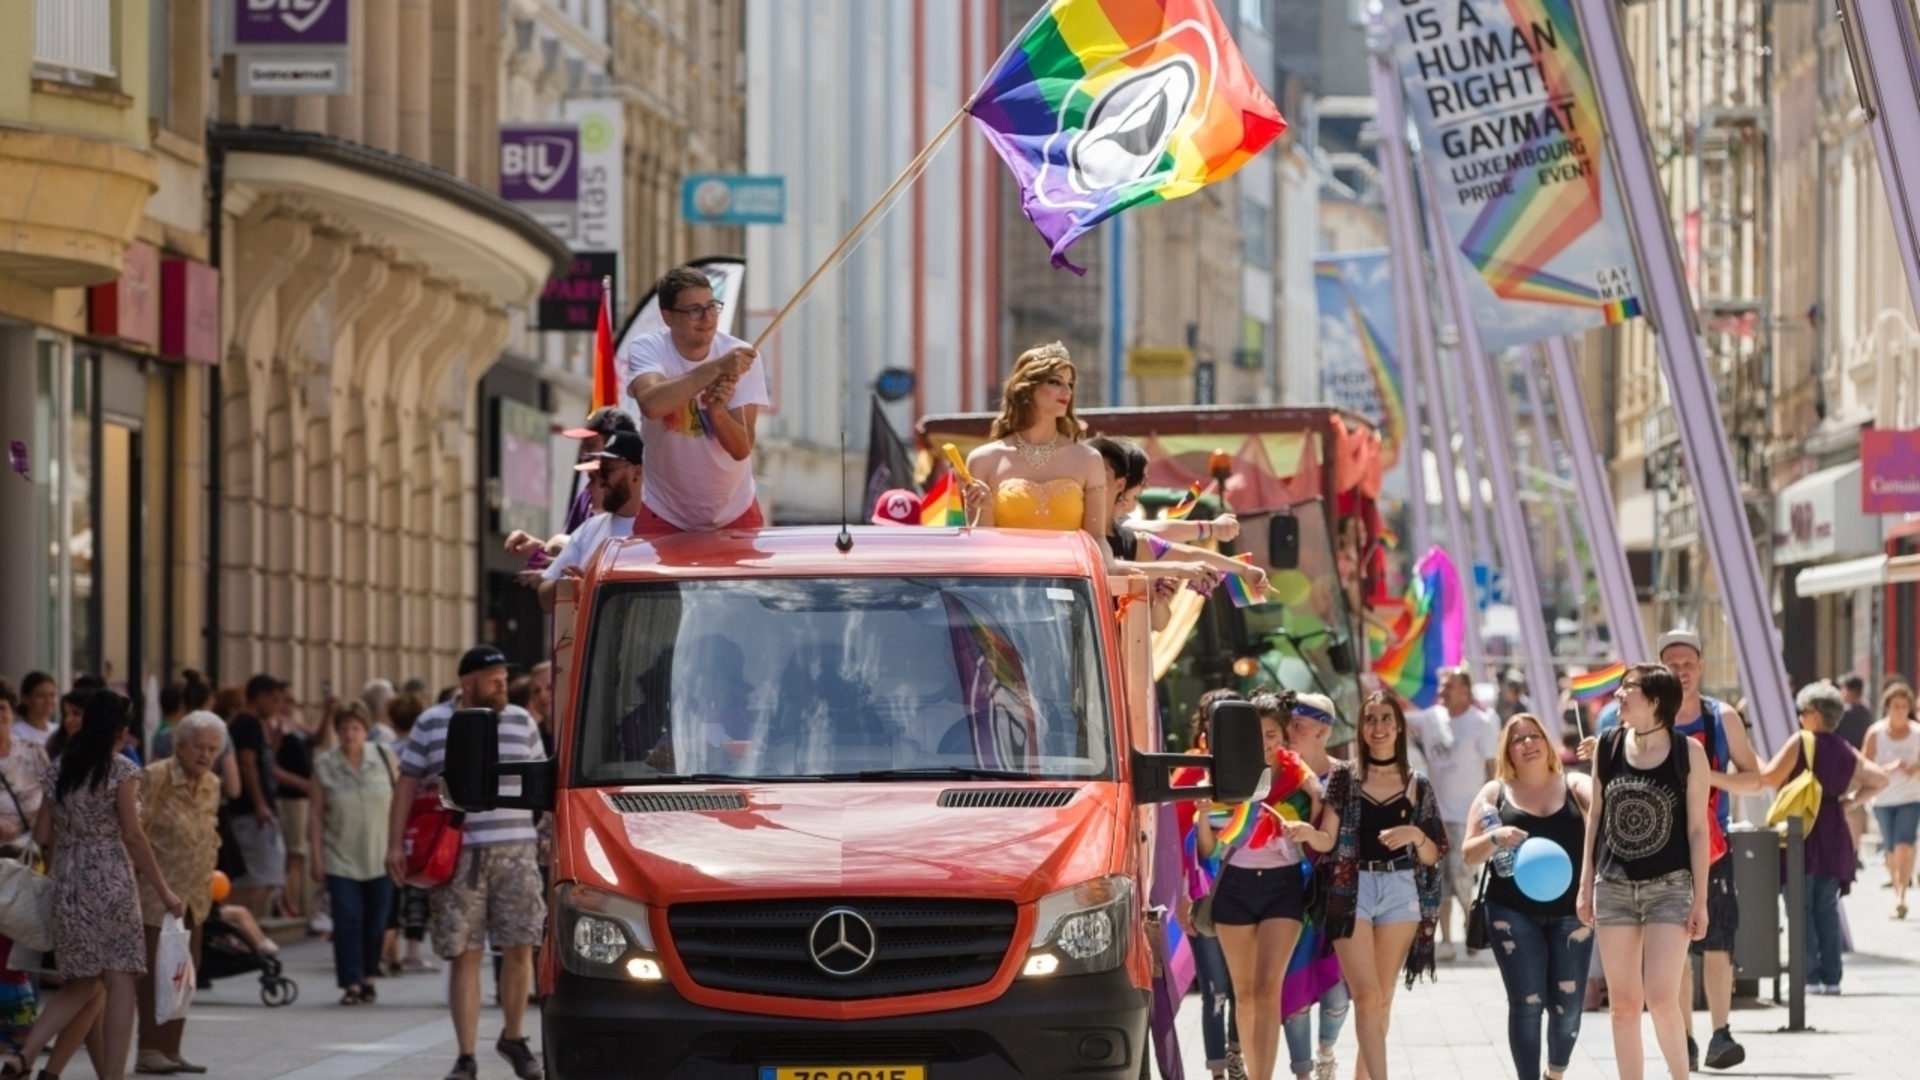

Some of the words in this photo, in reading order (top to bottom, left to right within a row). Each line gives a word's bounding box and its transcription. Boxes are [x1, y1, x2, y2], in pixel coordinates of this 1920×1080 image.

[1405, 8, 1442, 43] IS
[1458, 0, 1483, 32] A
[1416, 19, 1557, 80] HUMAN
[1427, 60, 1549, 118] RIGHT!
[1441, 102, 1576, 159] GAYMAT
[502, 143, 556, 177] BIL
[1451, 138, 1587, 185] LUXEMBOURG
[1457, 176, 1515, 205] PRIDE
[1538, 160, 1593, 185] EVENT
[1597, 264, 1628, 285] GAY
[1601, 281, 1633, 299] MAT
